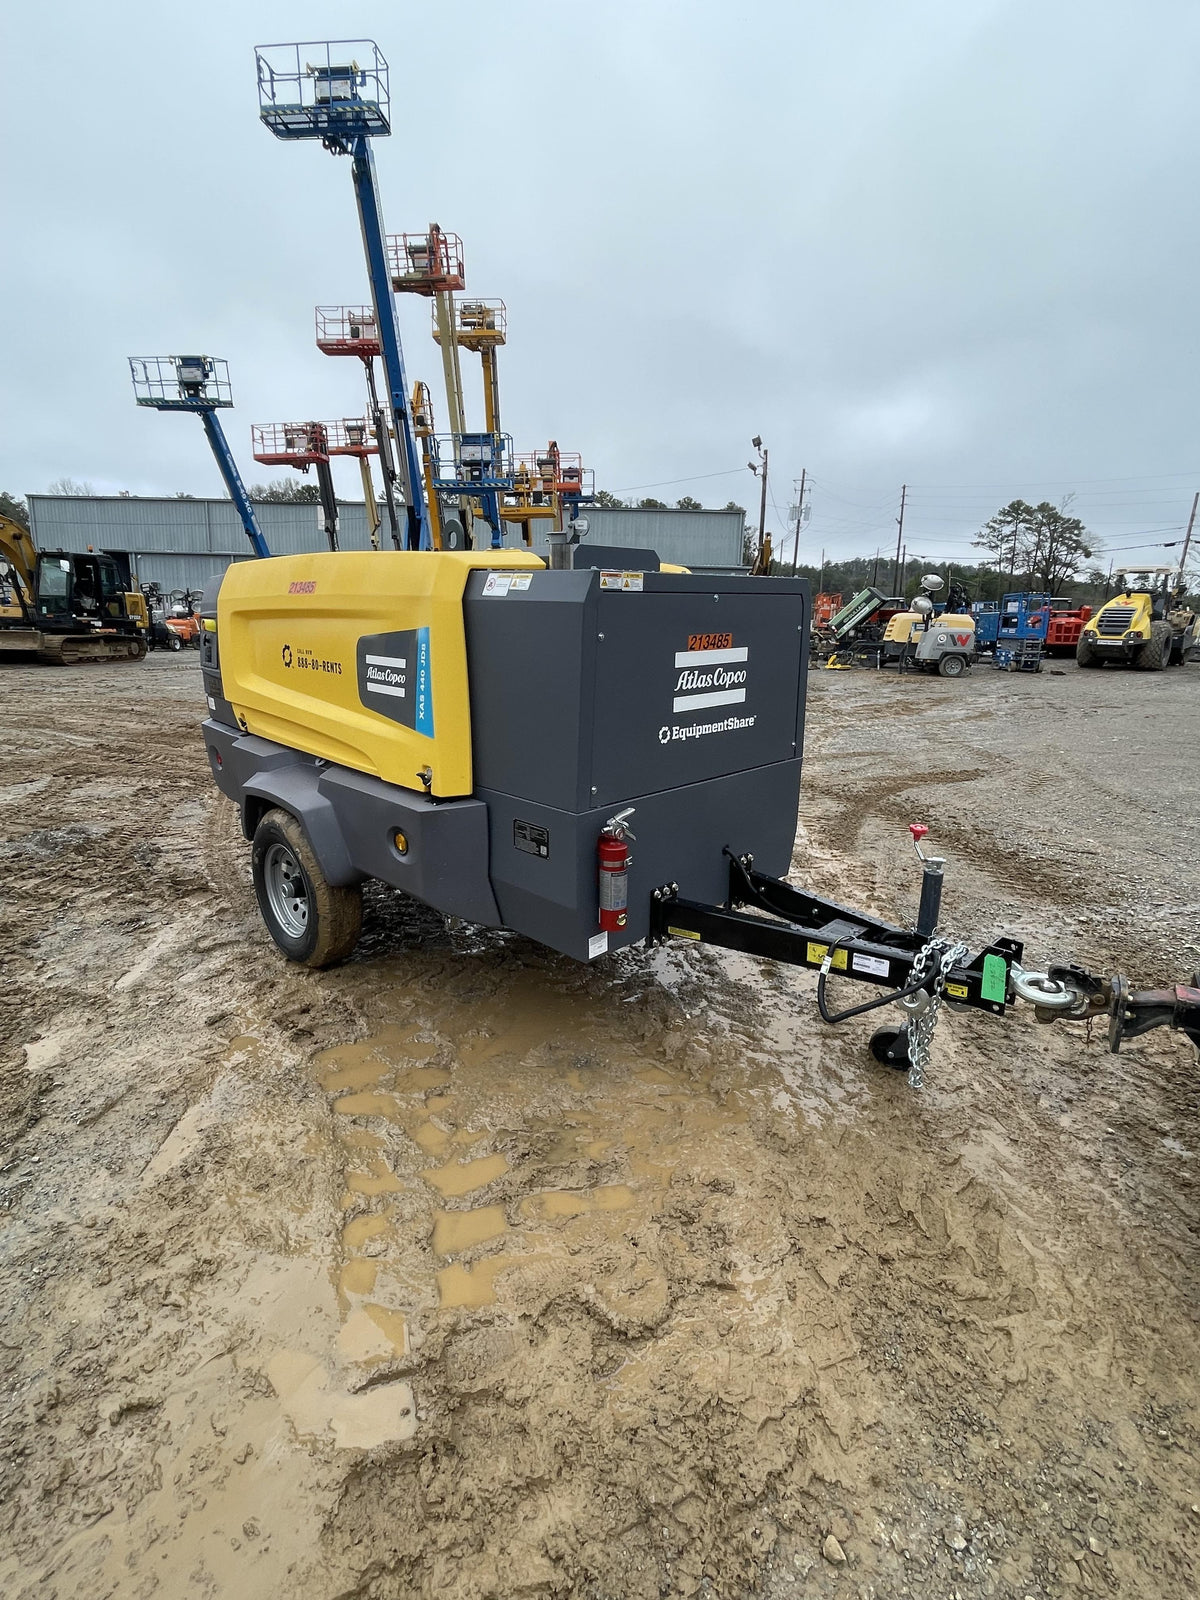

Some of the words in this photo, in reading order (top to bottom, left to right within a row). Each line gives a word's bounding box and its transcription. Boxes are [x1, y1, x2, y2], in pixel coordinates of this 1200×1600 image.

[288, 581, 316, 594] 213485
[689, 634, 730, 650] 213485
[297, 657, 342, 675] 888-80-RENTS
[366, 666, 385, 681] Atlas
[385, 670, 406, 684] Copco
[674, 670, 712, 691] Atlas
[713, 667, 747, 689] Copco
[672, 716, 755, 741] EquipmentShare
